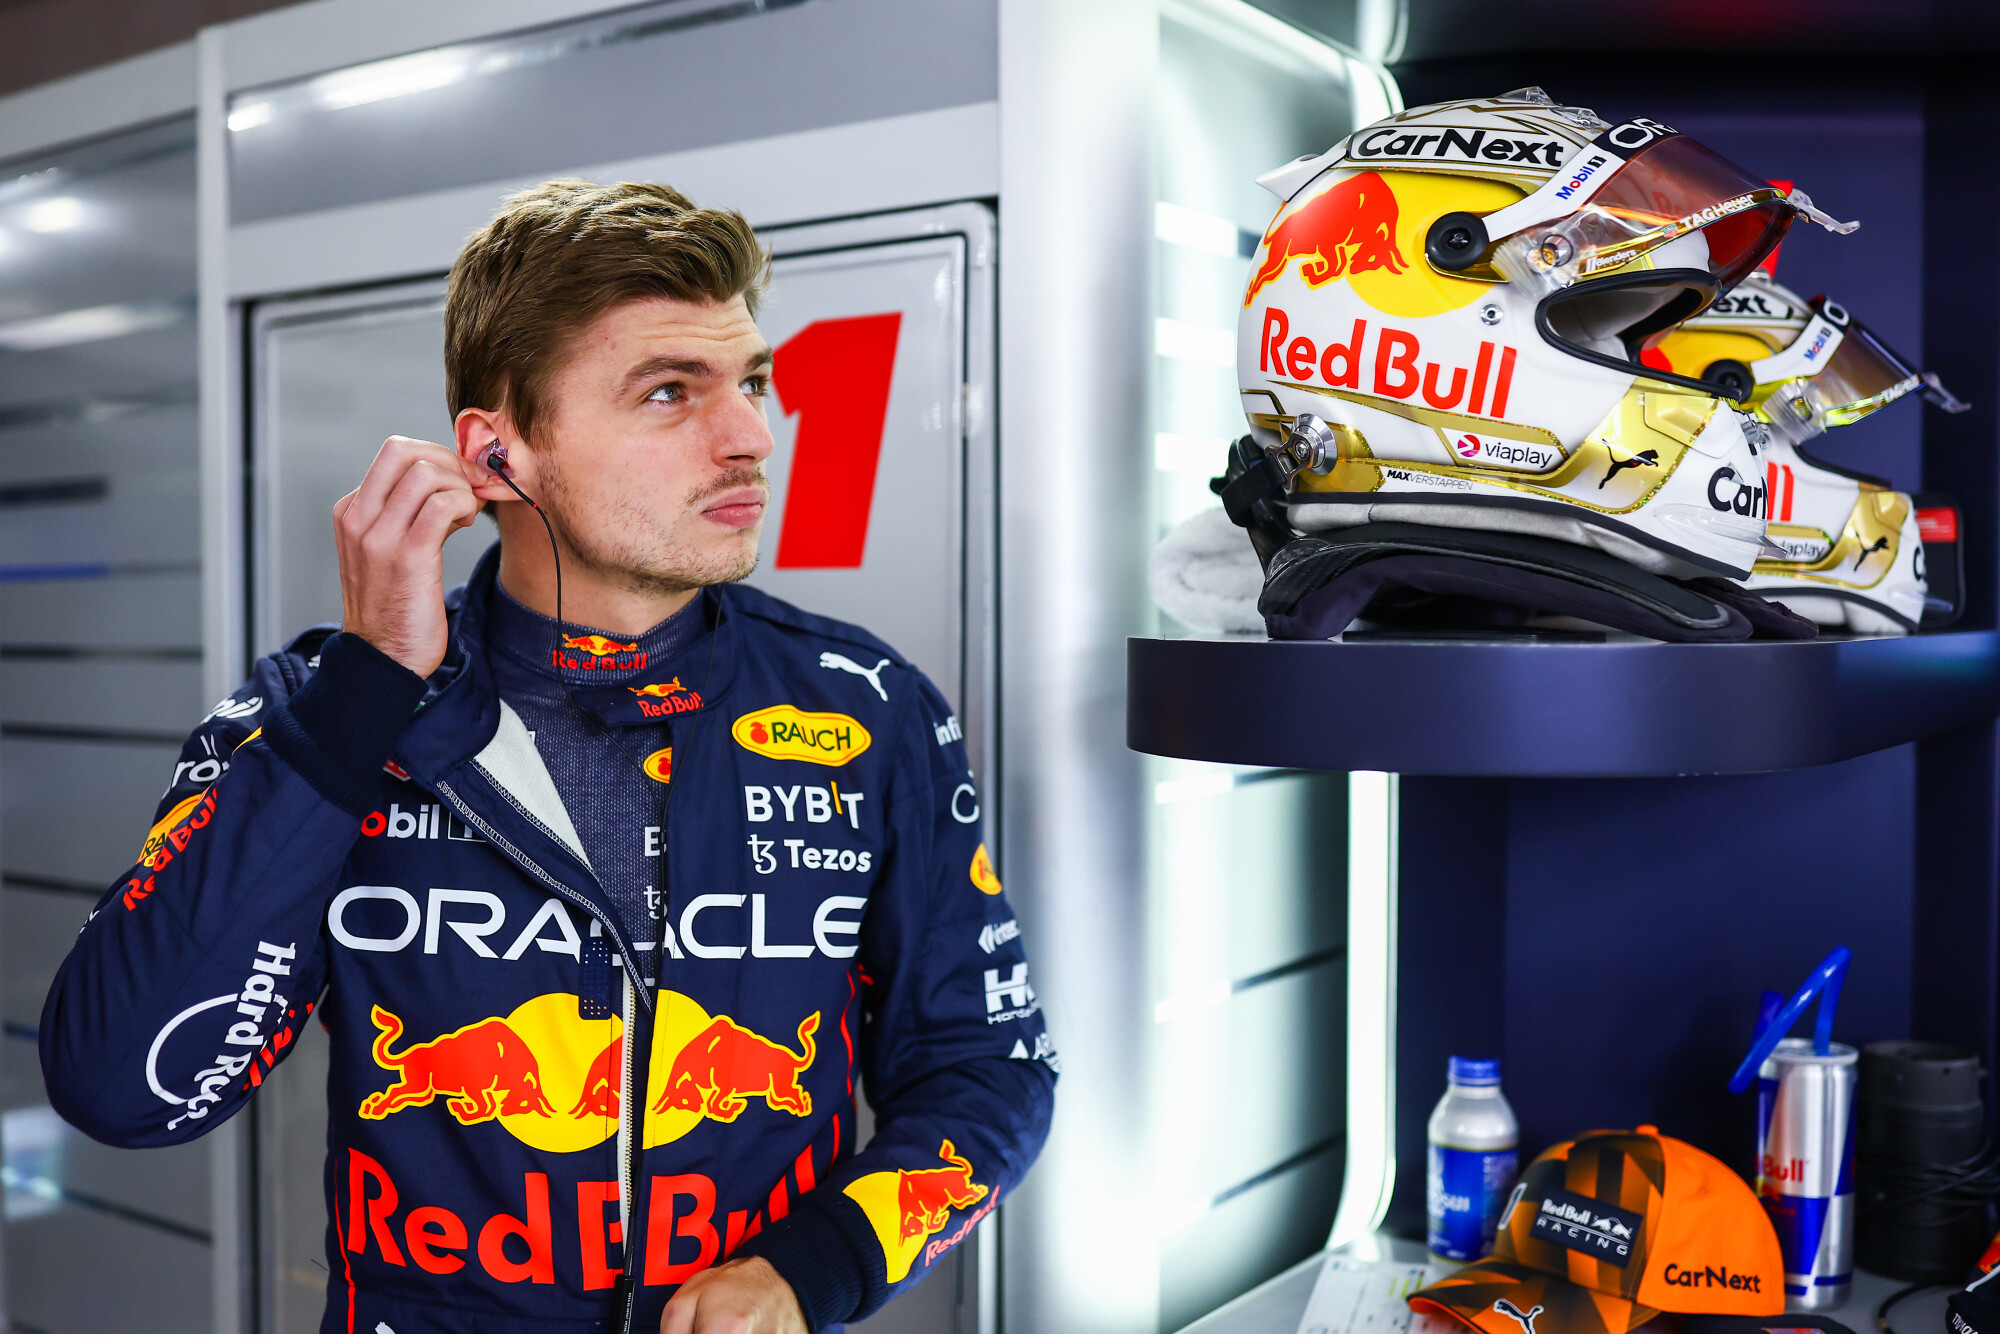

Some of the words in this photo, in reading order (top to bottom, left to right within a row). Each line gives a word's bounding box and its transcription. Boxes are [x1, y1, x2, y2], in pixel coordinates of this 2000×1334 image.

[1357, 128, 1564, 168] CarNext
[1555, 164, 1596, 200] Mobil
[1712, 294, 1772, 314] ext
[1260, 306, 1367, 390] Red
[1373, 327, 1518, 419] Bull
[771, 311, 904, 570] 1
[1485, 441, 1554, 468] viaplay
[552, 649, 597, 670] Red
[601, 652, 648, 670] Bull
[637, 697, 674, 718] Red
[670, 691, 704, 713] Bull
[771, 721, 852, 752] RAUCH
[360, 803, 441, 840] obil
[744, 780, 865, 830] BYBIT
[783, 838, 873, 873] Tezos
[225, 940, 297, 1046] Hard
[347, 1146, 556, 1285] Red
[1541, 1198, 1567, 1217] Red
[1563, 1203, 1592, 1225] Bull
[924, 1219, 970, 1267] Red
[1536, 1217, 1629, 1256] RACING
[1664, 1262, 1762, 1294] CarNext
